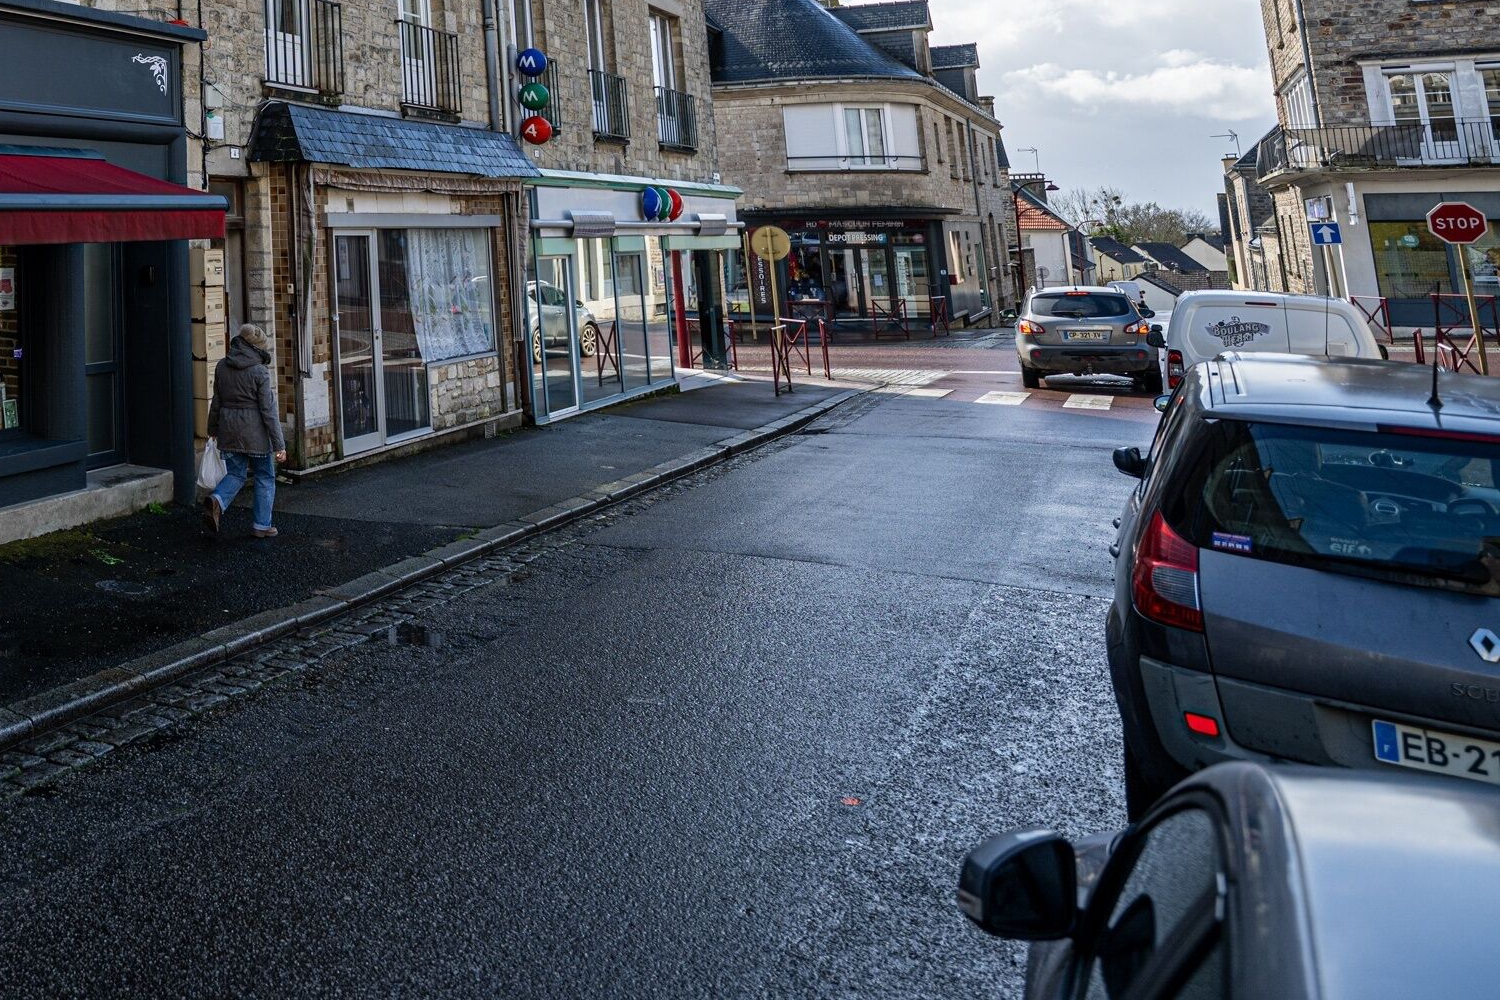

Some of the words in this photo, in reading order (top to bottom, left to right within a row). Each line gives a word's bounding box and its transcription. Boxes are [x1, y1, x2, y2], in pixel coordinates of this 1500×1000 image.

[1435, 217, 1480, 230] STOP
[828, 234, 851, 242] DEPOT
[851, 234, 883, 242] PRESSING
